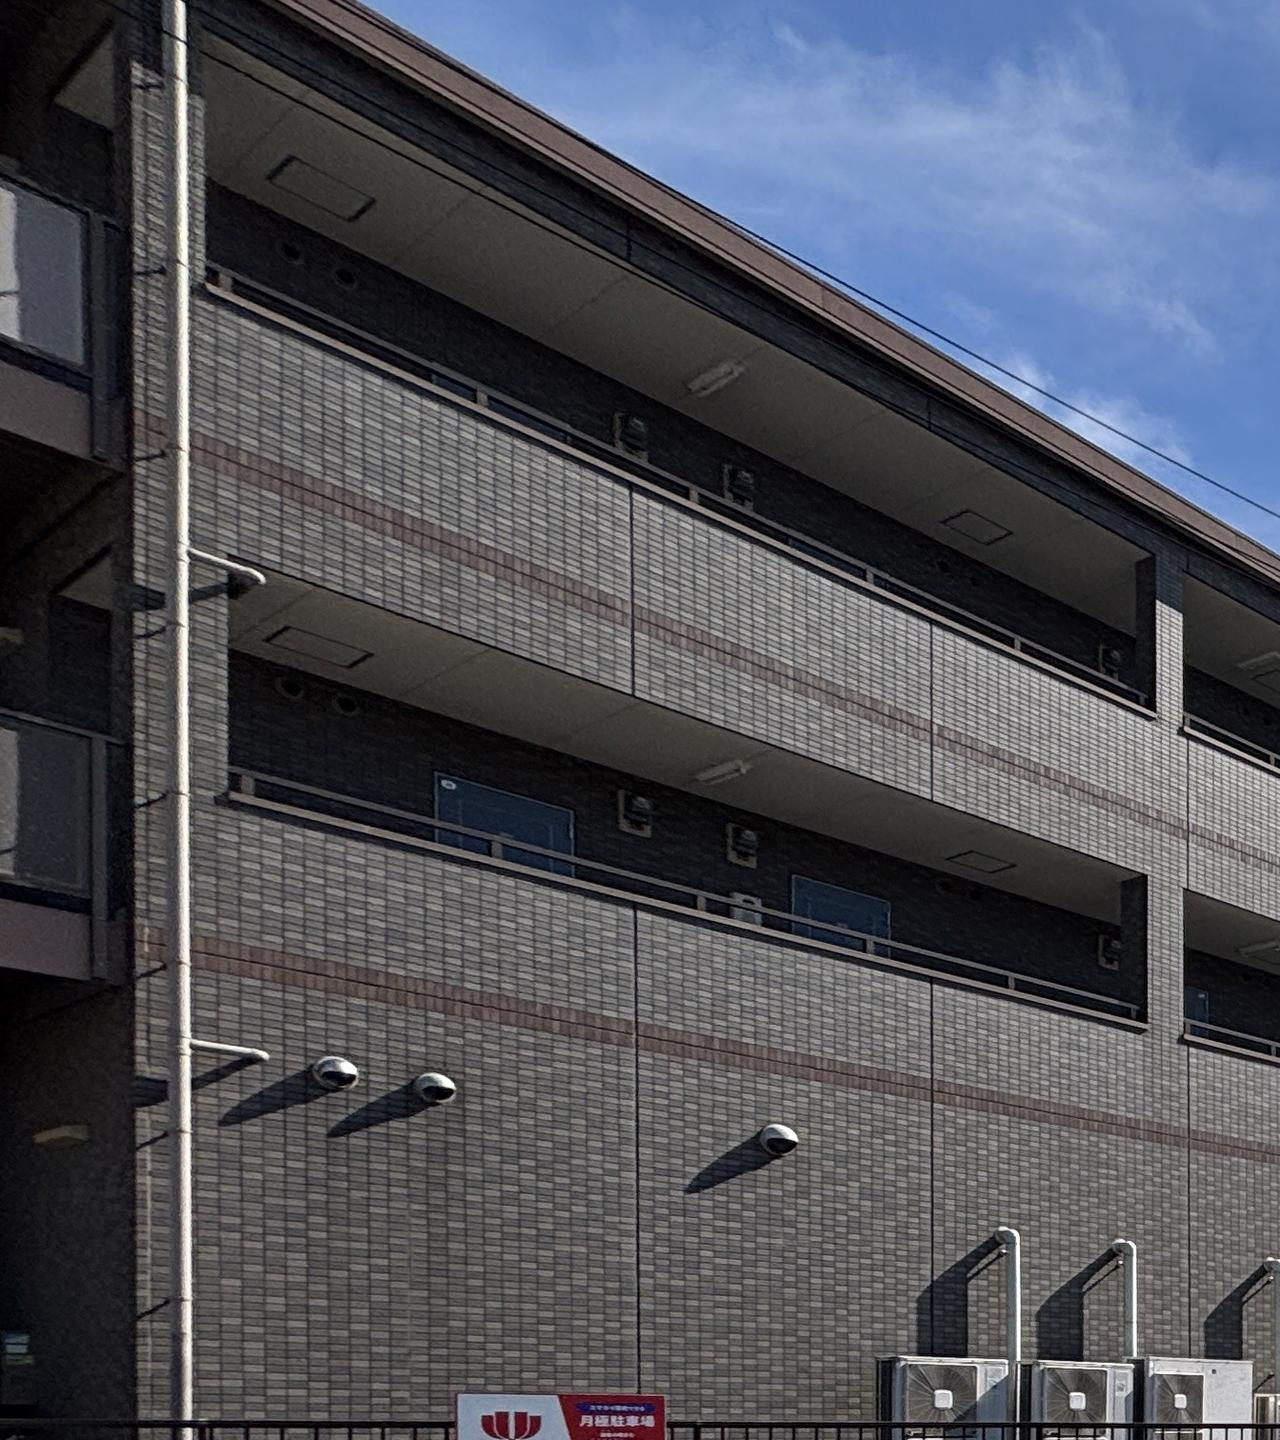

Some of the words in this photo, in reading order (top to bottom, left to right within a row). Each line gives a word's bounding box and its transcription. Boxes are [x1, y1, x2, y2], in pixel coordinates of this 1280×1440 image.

[579, 1414, 656, 1427] 月極駐車場
